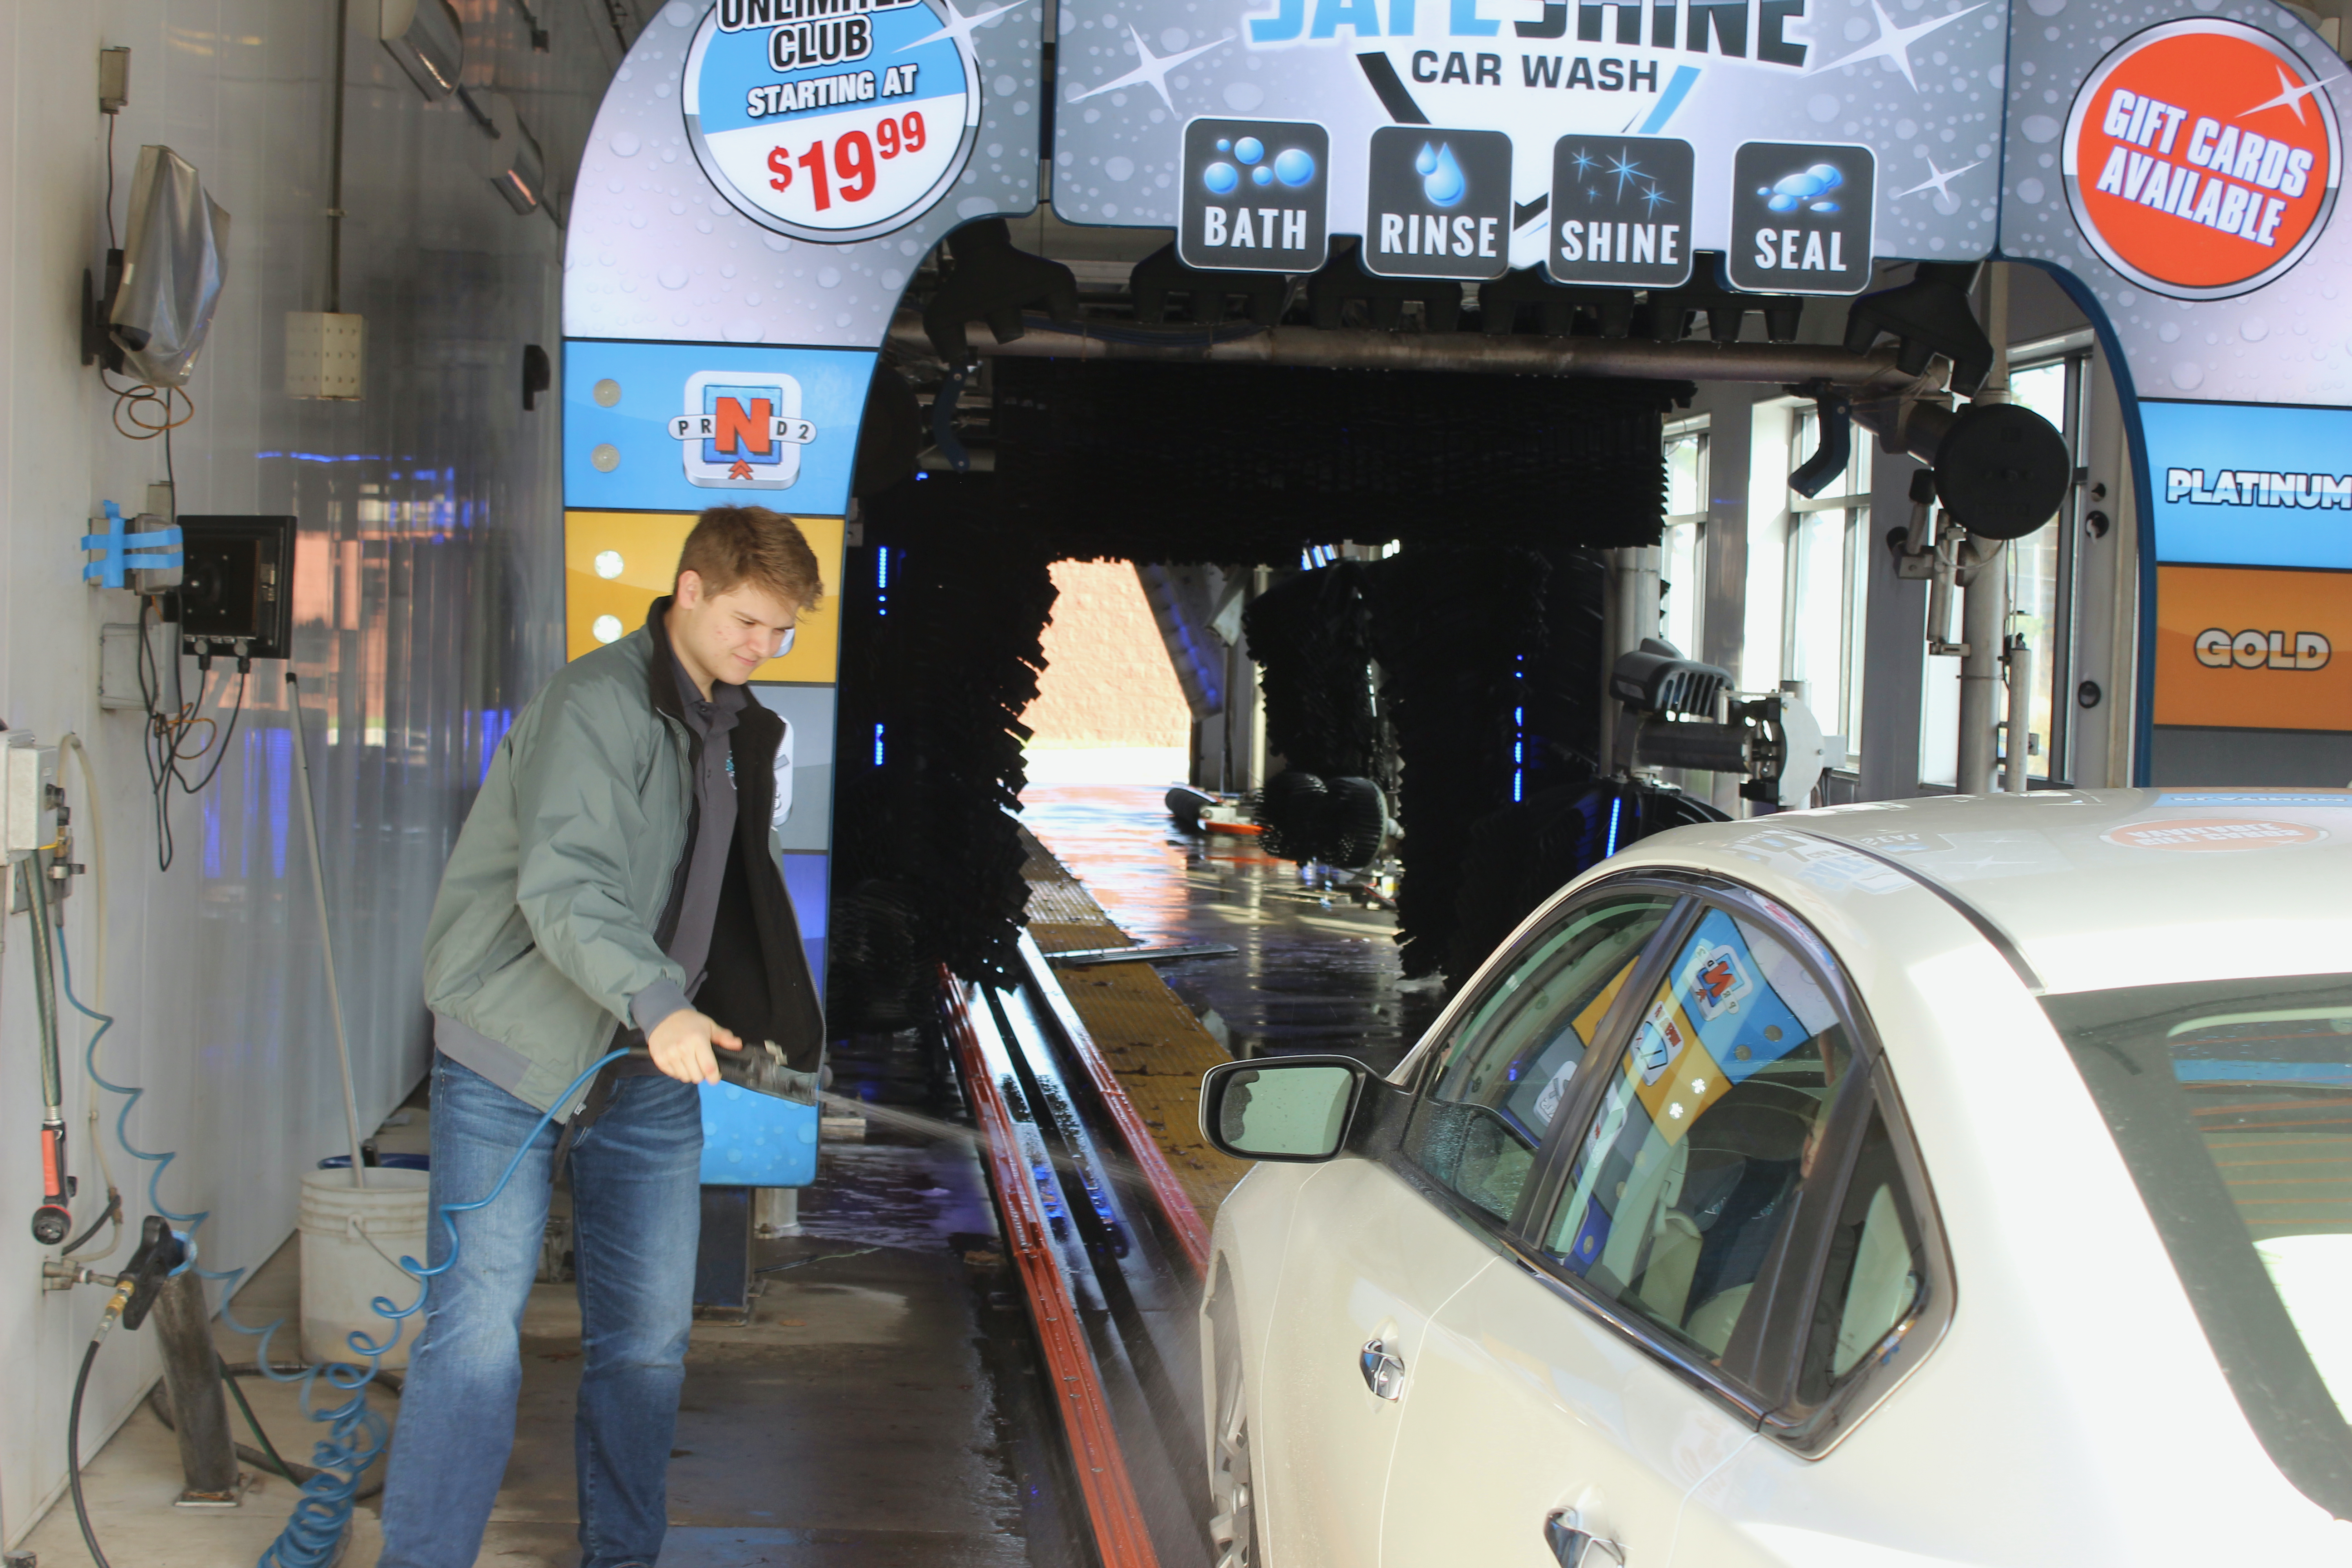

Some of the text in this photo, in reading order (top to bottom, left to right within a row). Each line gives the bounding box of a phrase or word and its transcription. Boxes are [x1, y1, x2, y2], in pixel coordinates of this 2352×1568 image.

[771, 17, 870, 69] CLUB
[747, 64, 917, 117] STARTING AT
[1412, 49, 1658, 93] CAR WASH
[2103, 88, 2313, 198] GIFT CARDS
[2096, 145, 2286, 247] AVAILABLE
[1204, 205, 1307, 250] BATH
[1380, 212, 1499, 259] RINSE
[1560, 219, 1680, 265] SHINE
[1754, 227, 1847, 272] SEAL
[2166, 468, 2352, 510] PLATINUM
[2194, 627, 2332, 671] GOLD
